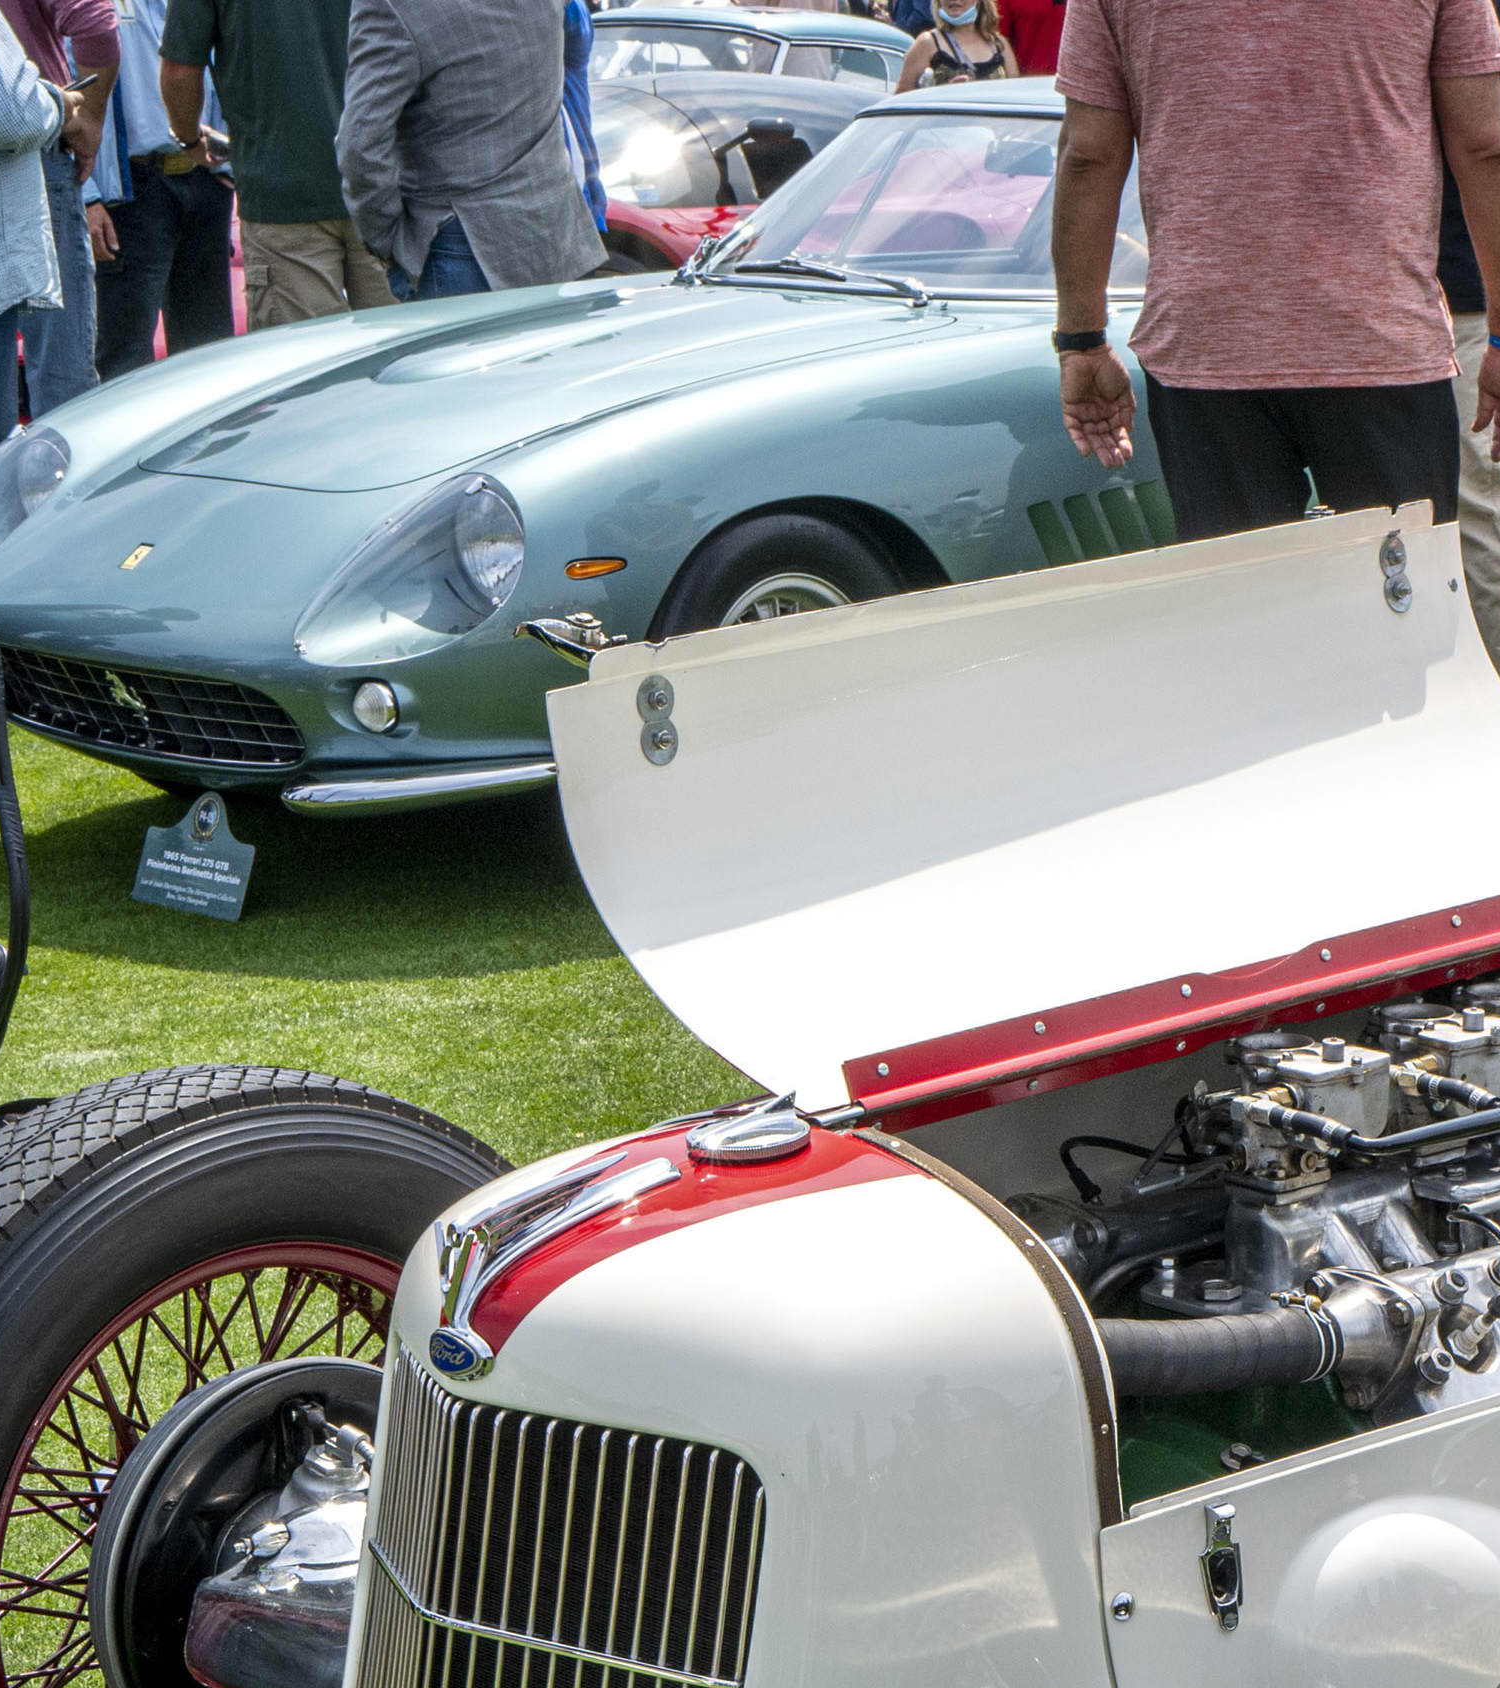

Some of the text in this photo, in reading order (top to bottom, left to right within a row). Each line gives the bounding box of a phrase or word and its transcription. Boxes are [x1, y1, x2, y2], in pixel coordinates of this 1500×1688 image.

[163, 850, 180, 862] 1965
[179, 853, 202, 865] Ferrari
[430, 1337, 466, 1366] Ford
